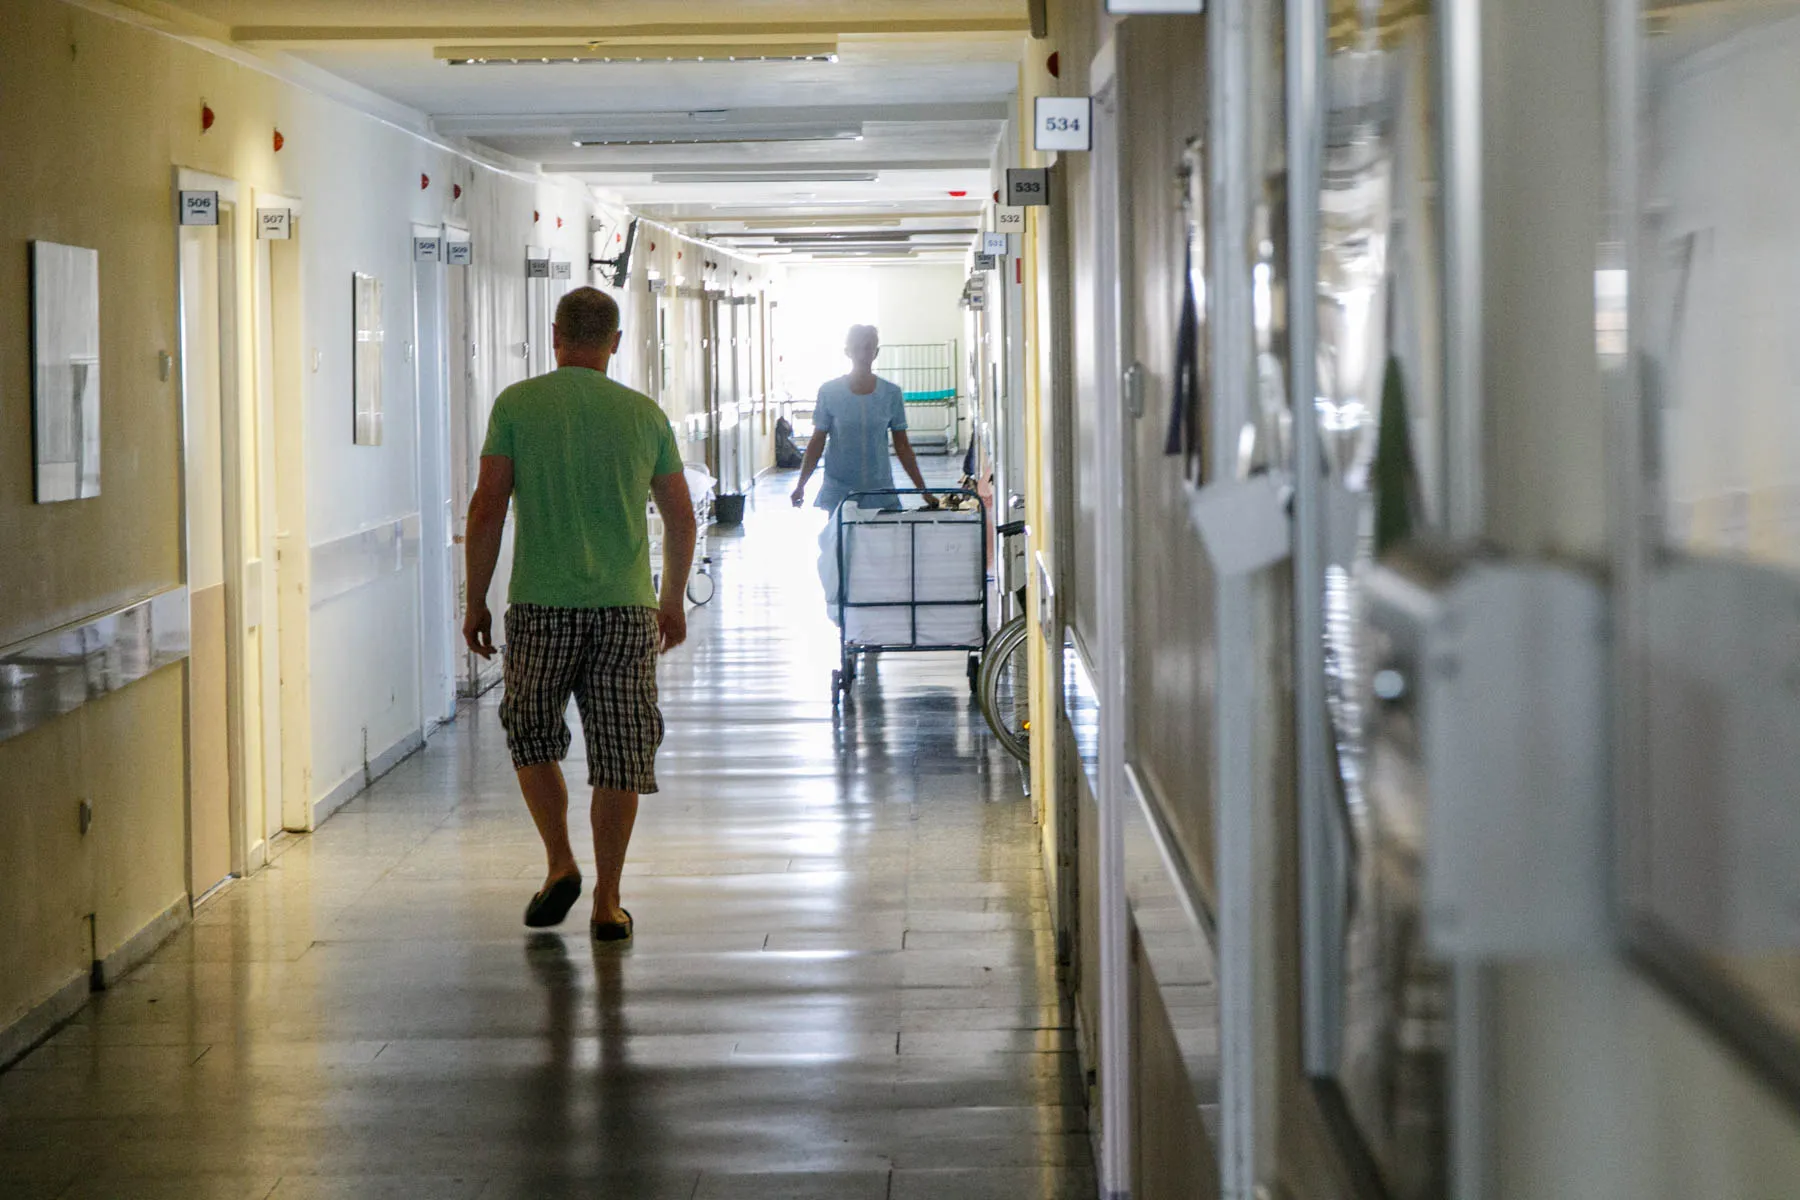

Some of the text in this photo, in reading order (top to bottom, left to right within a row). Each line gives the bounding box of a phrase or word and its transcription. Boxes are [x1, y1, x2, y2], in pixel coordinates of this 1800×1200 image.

[1046, 117, 1080, 131] 534
[1015, 182, 1040, 192] 533
[187, 197, 211, 207] 506
[263, 214, 284, 223] 507
[1000, 214, 1020, 223] 532
